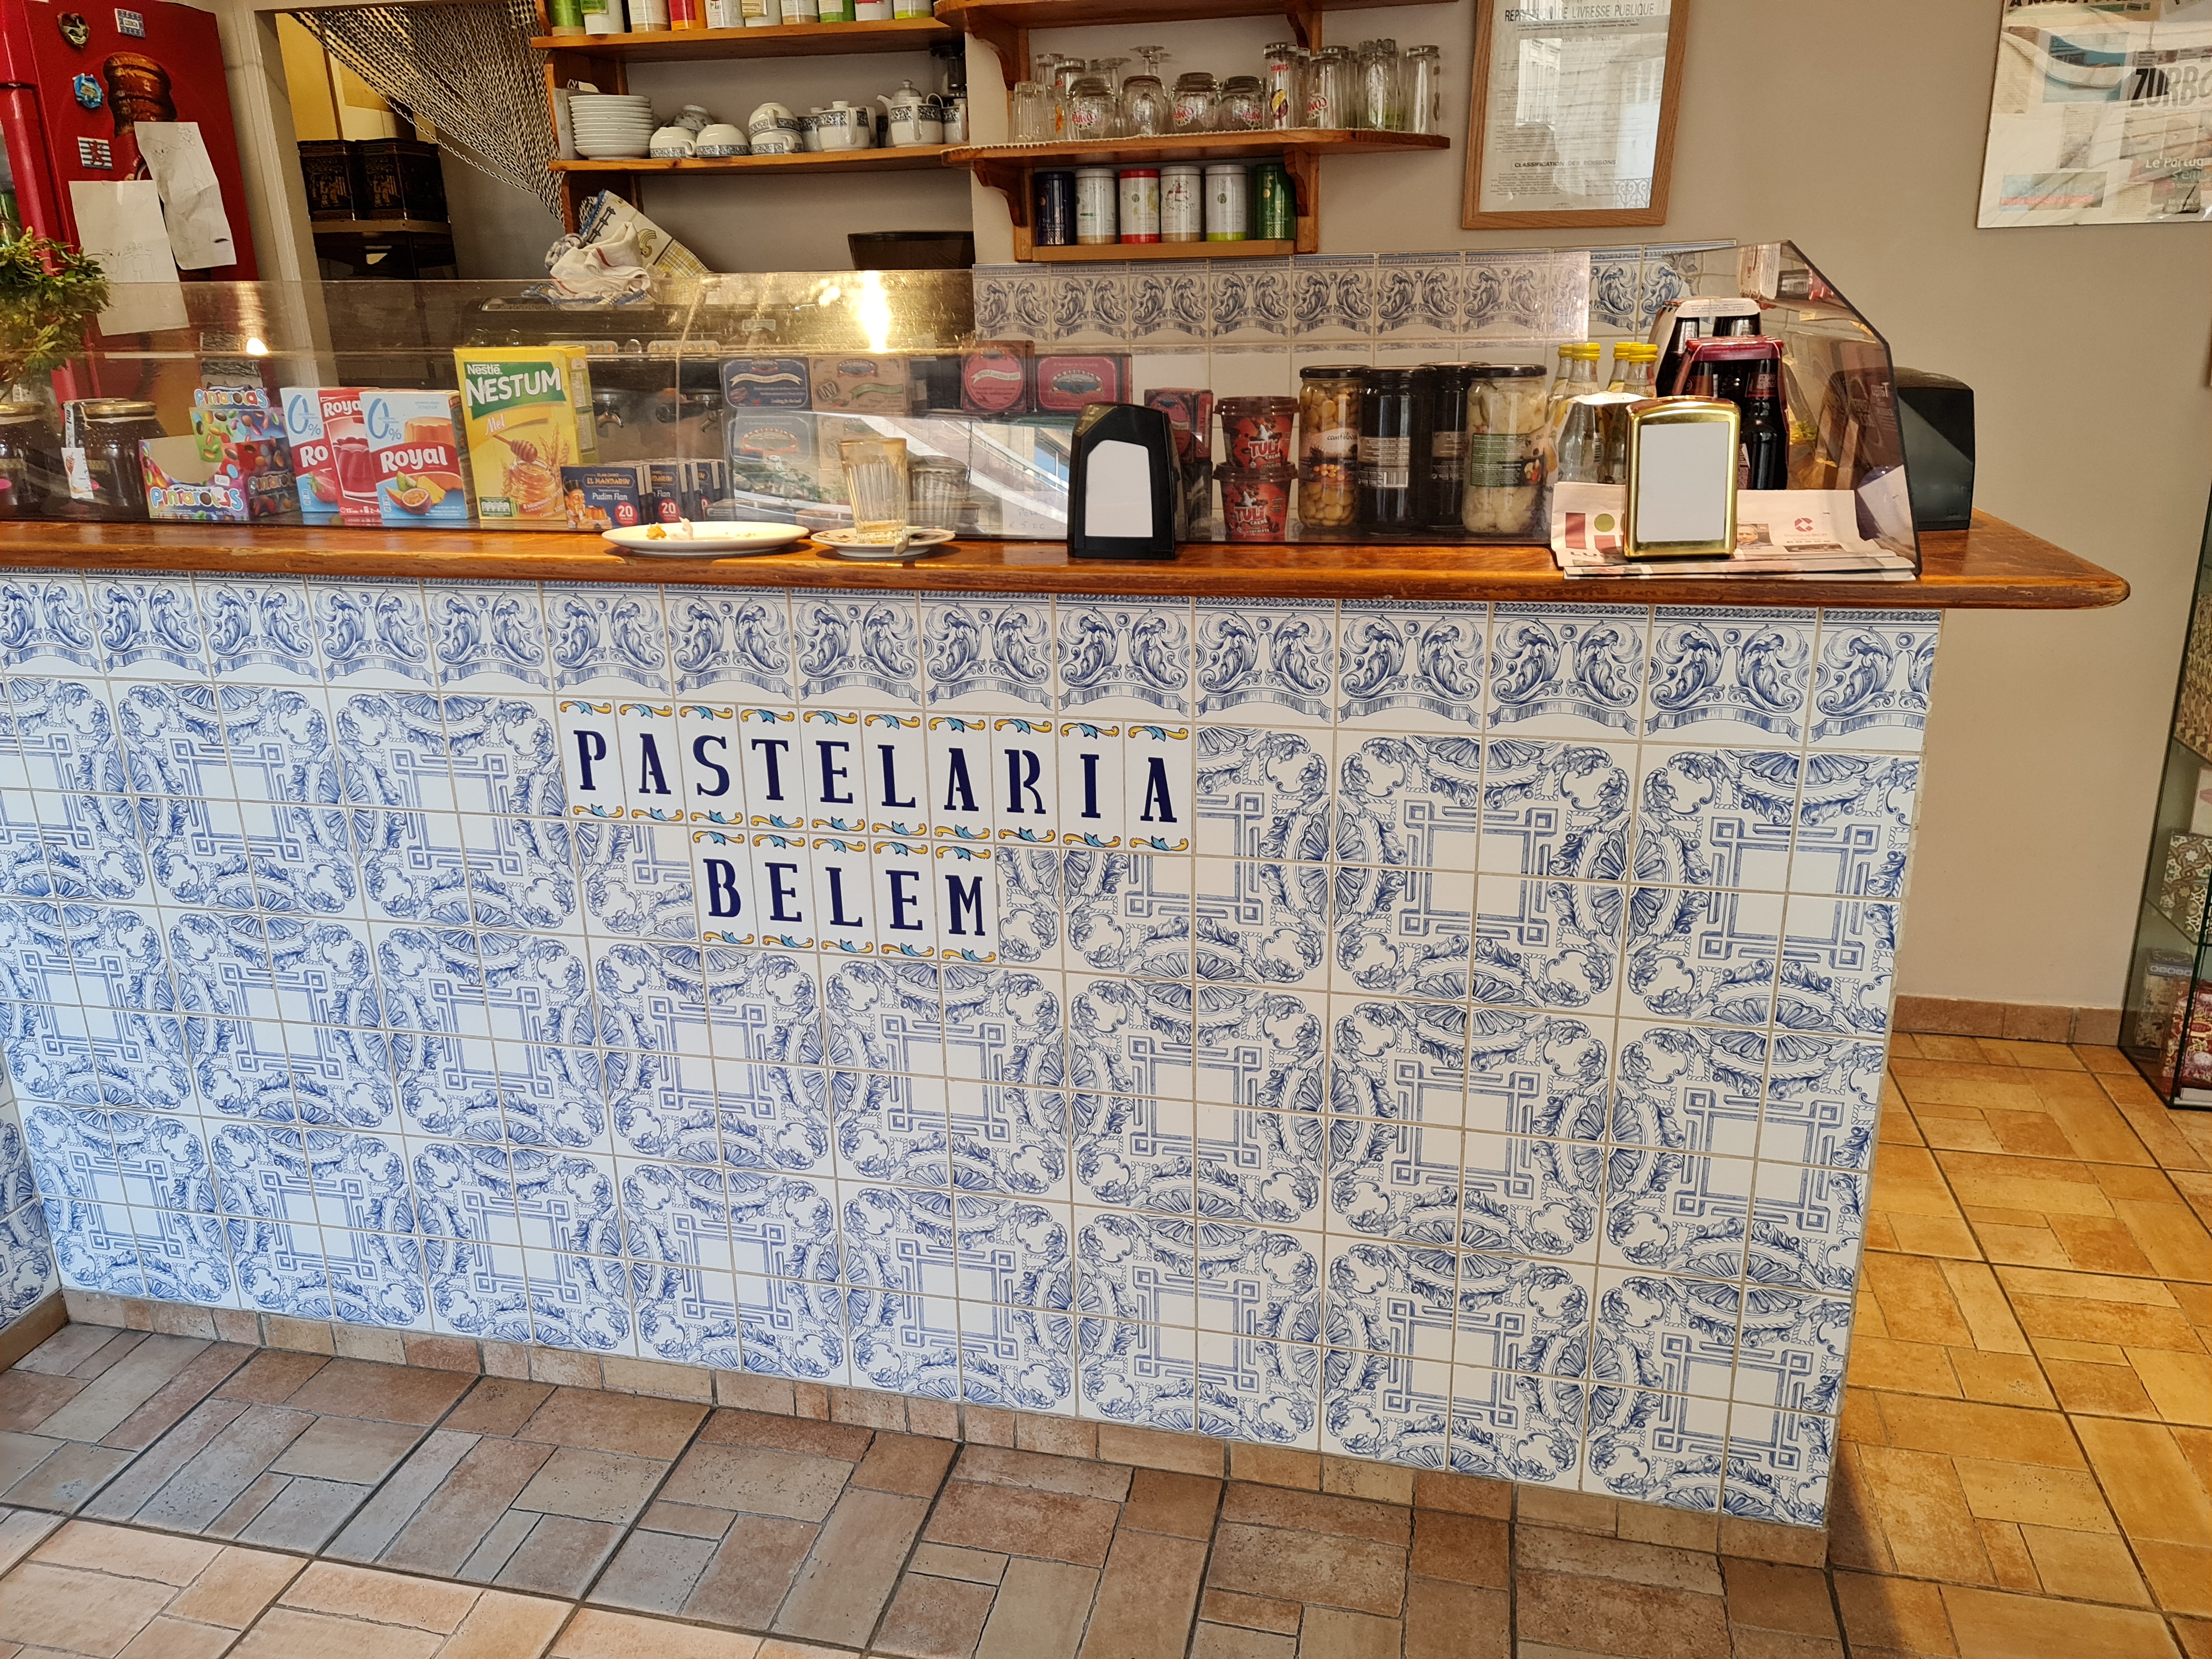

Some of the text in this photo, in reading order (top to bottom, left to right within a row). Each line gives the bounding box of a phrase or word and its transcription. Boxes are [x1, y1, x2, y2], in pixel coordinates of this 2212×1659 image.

[1572, 4, 1610, 18] L'IVRESSE
[1614, 3, 1655, 16] PUBLIQUE
[465, 367, 562, 407] NESTUM
[323, 399, 362, 418] Roya
[486, 413, 506, 436] Mel
[379, 445, 448, 474] Royal
[592, 492, 628, 500] Pudim Flan
[618, 505, 633, 518] 20
[661, 502, 676, 514] 20
[573, 730, 1177, 823] PASTELARIA
[703, 858, 986, 937] BELEM
